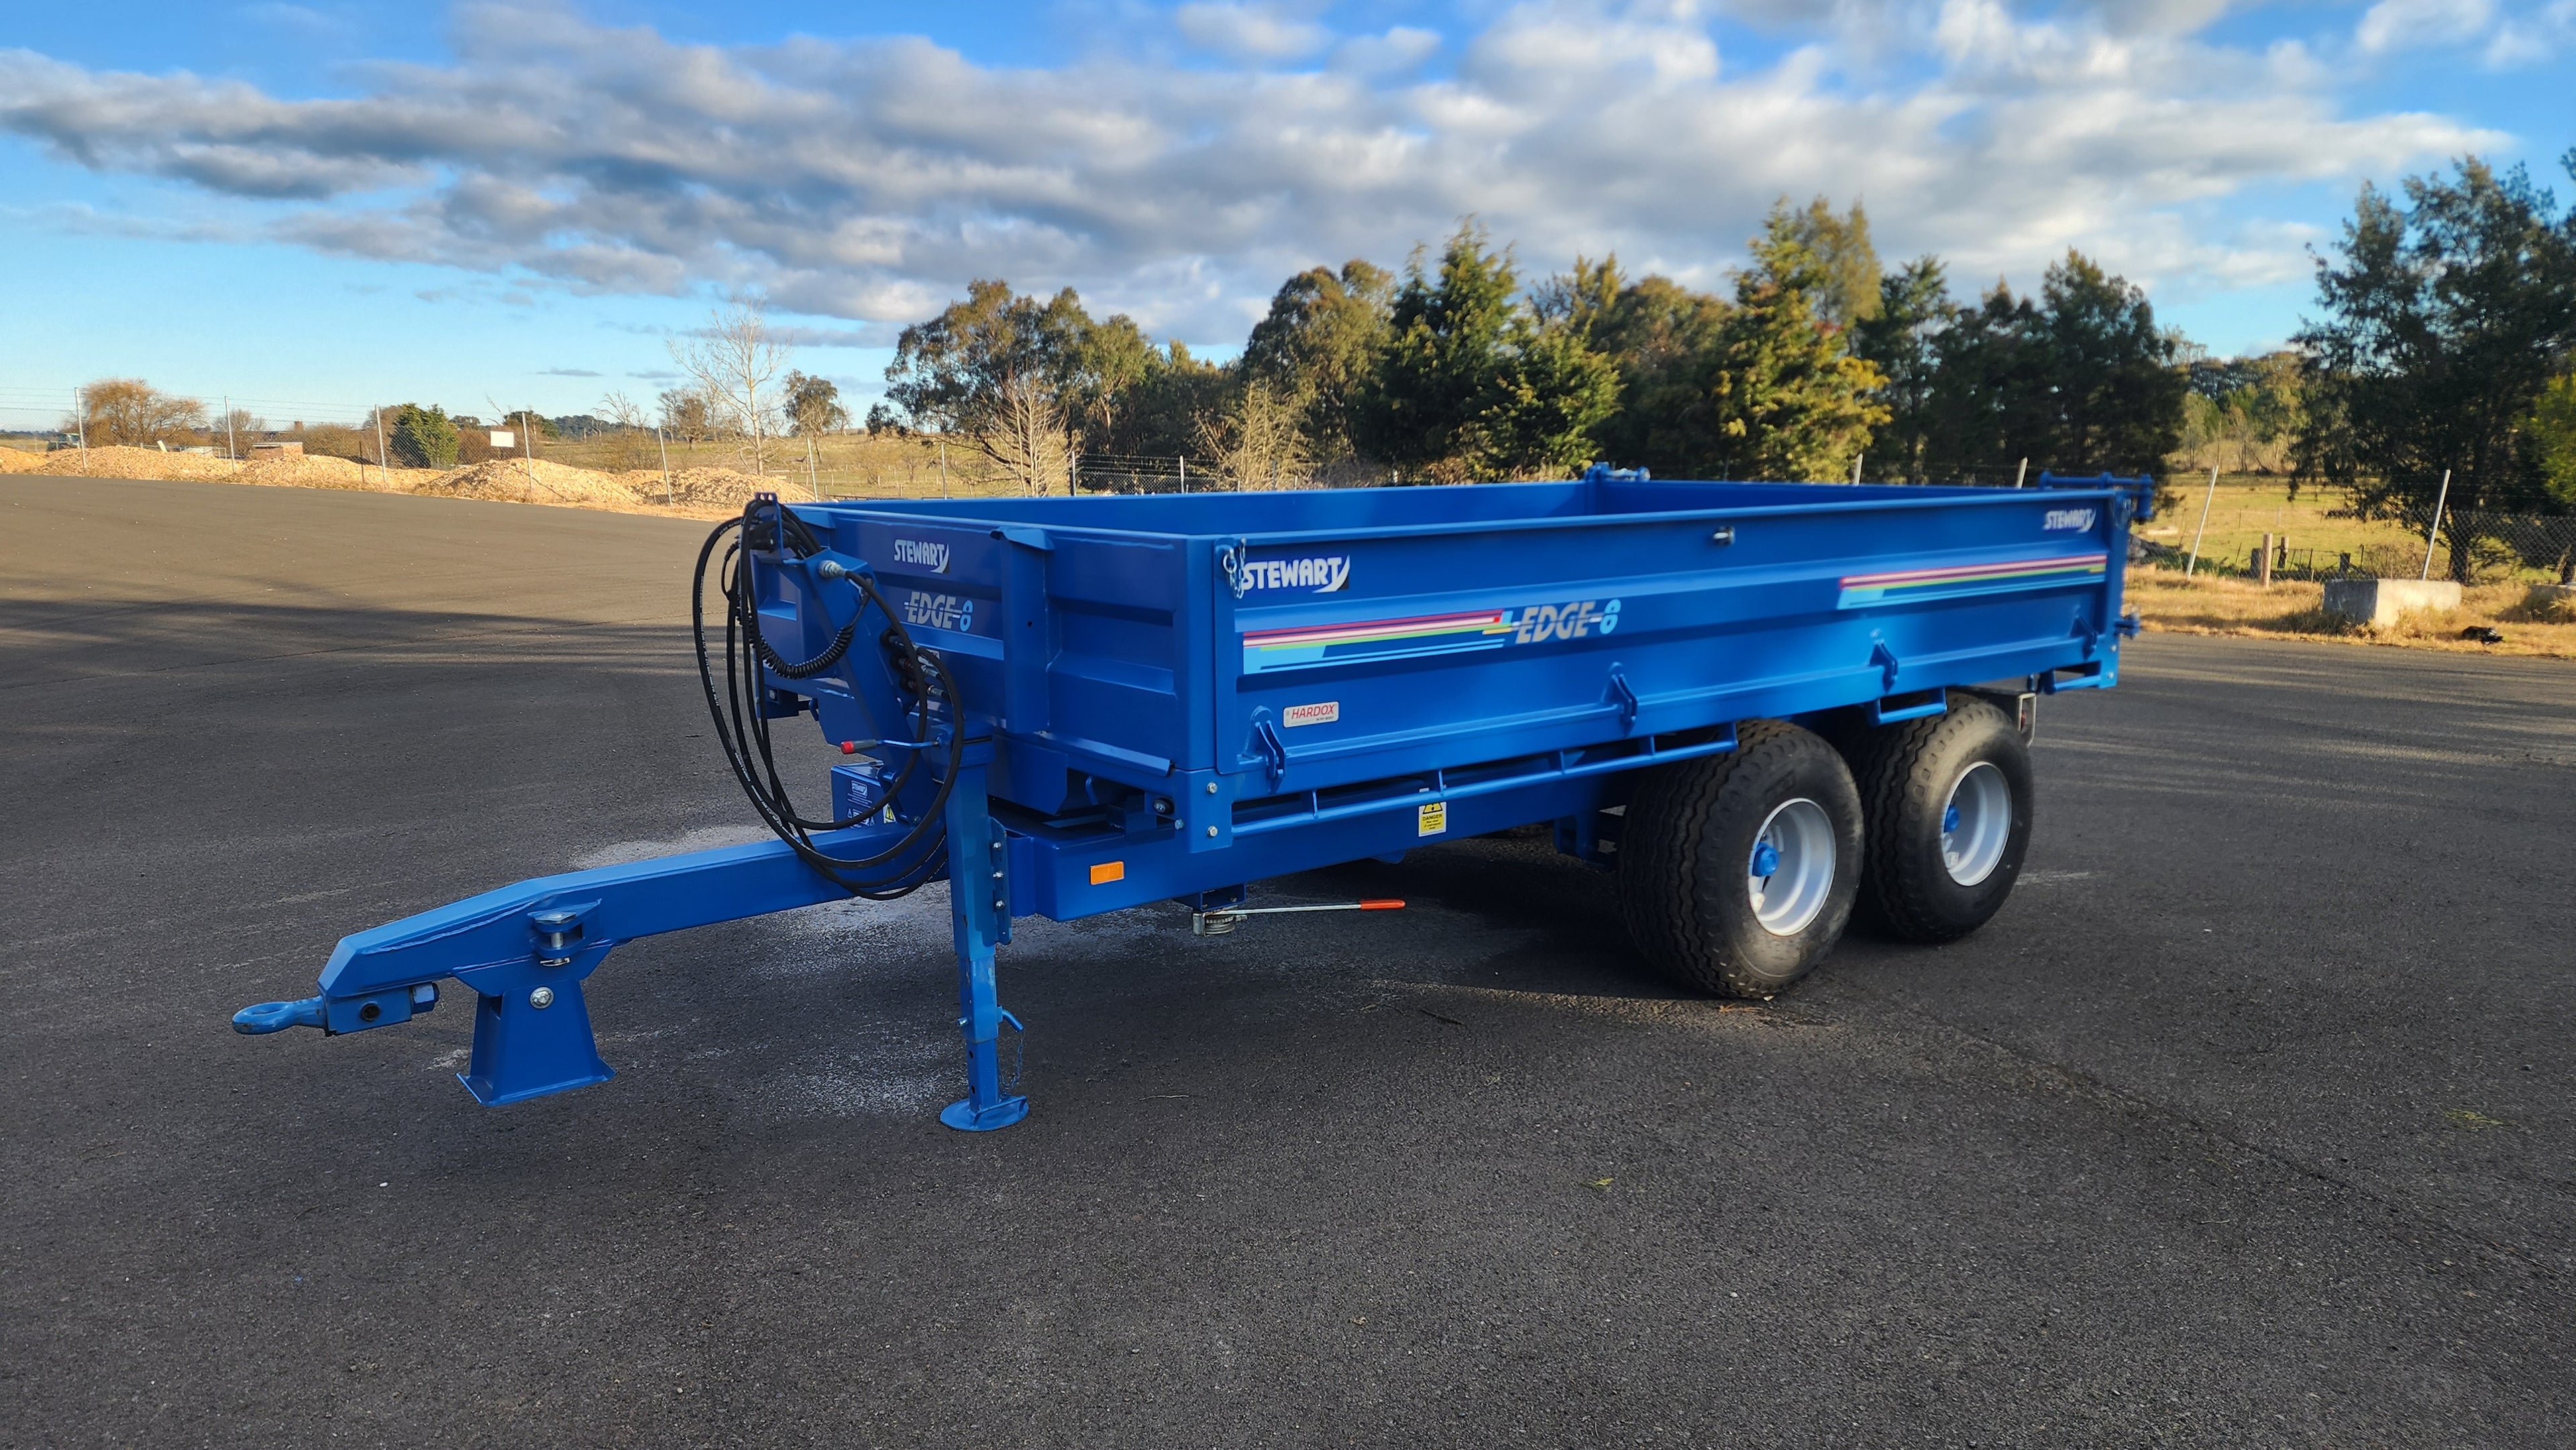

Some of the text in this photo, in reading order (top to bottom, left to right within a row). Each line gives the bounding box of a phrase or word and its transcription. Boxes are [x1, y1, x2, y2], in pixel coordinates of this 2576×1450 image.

[2041, 508, 2096, 533] STEWART
[894, 539, 950, 573] STEWART
[1242, 555, 1350, 594] STEWART
[1291, 704, 1335, 720] HARDOX
